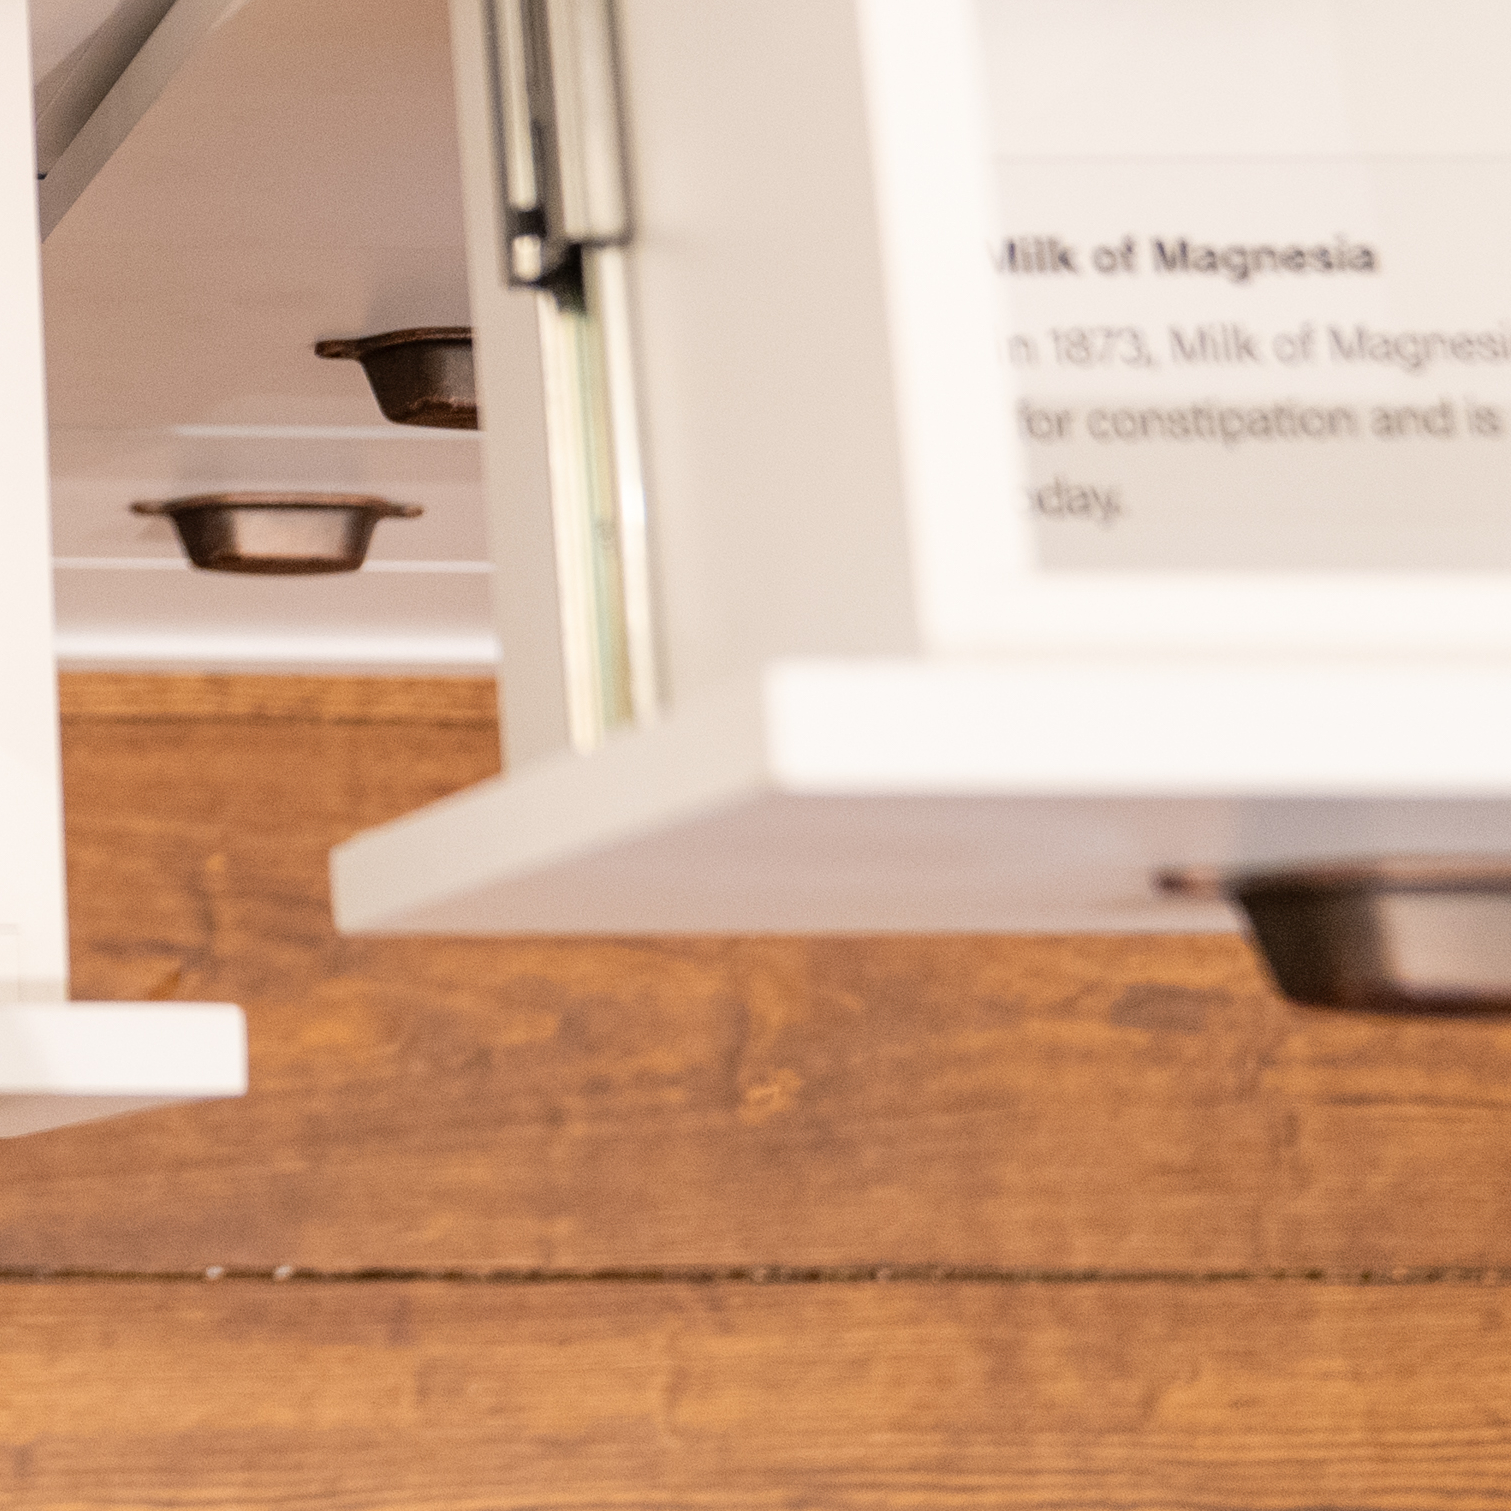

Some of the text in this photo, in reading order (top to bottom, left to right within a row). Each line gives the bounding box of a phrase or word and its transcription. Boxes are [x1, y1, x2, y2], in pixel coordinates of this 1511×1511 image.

[1091, 234, 1137, 274] of
[1150, 234, 1379, 286] Magnesia
[1052, 327, 1155, 367] 1873,
[1168, 323, 1259, 365] Milk
[1270, 323, 1319, 365] of
[1328, 321, 1511, 377] Magnesi
[1086, 399, 1359, 451] constipation
[1370, 397, 1456, 441] and
[1465, 395, 1504, 440] is
